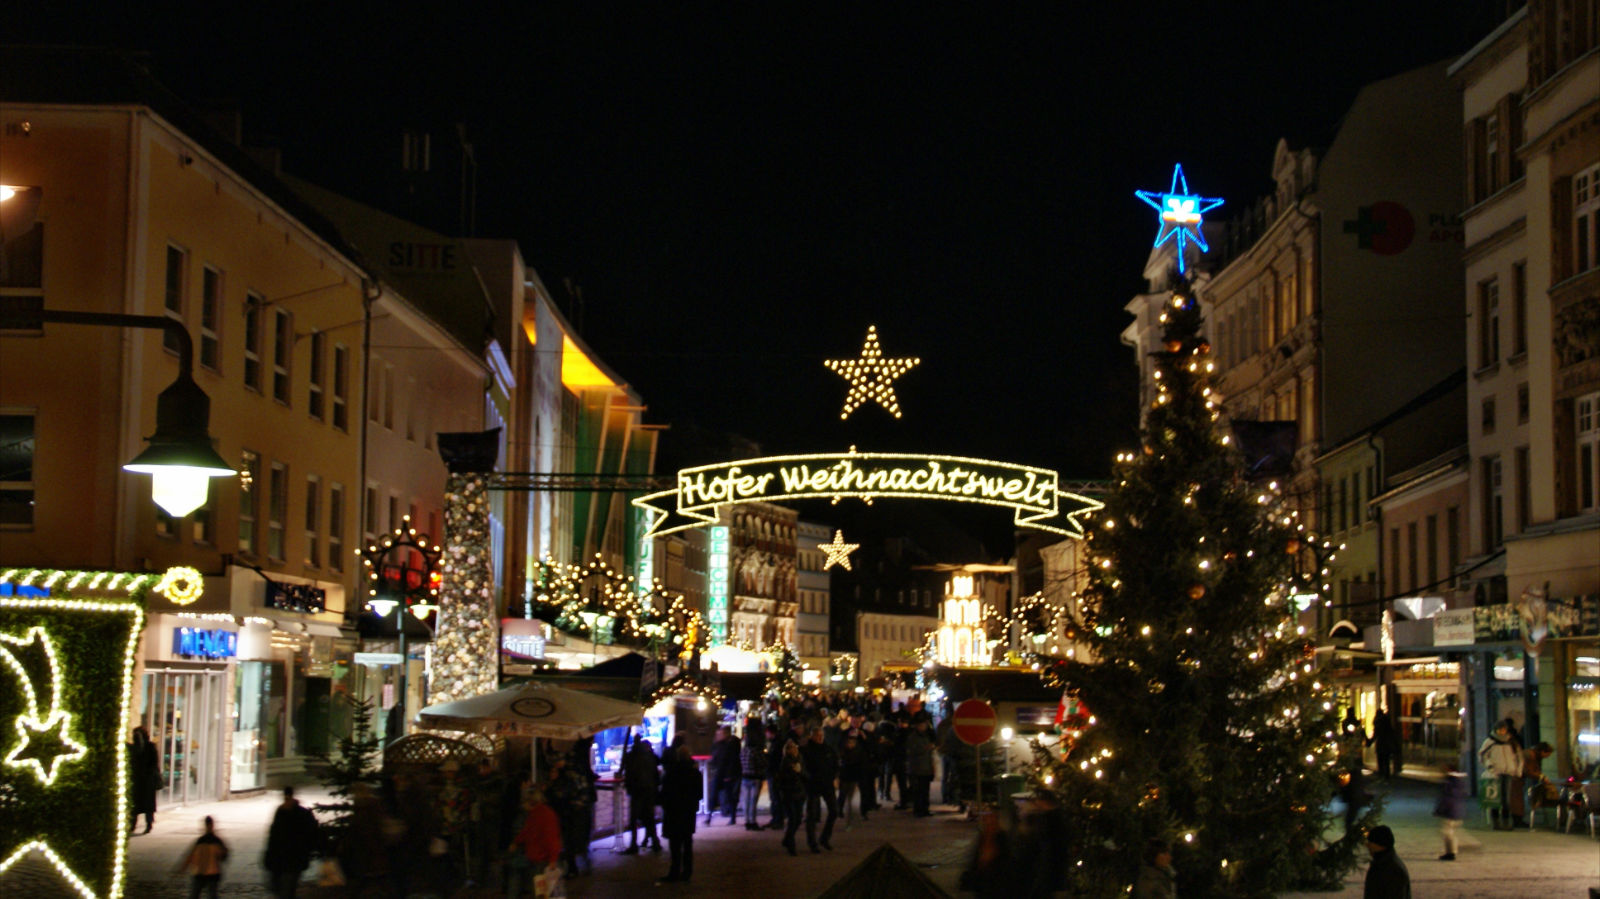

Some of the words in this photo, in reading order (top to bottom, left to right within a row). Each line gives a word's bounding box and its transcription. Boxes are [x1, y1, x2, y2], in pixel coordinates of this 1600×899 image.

[389, 242, 456, 268] SITTE
[682, 466, 775, 505] Hofer
[779, 459, 1053, 507] Weihnachtswelt
